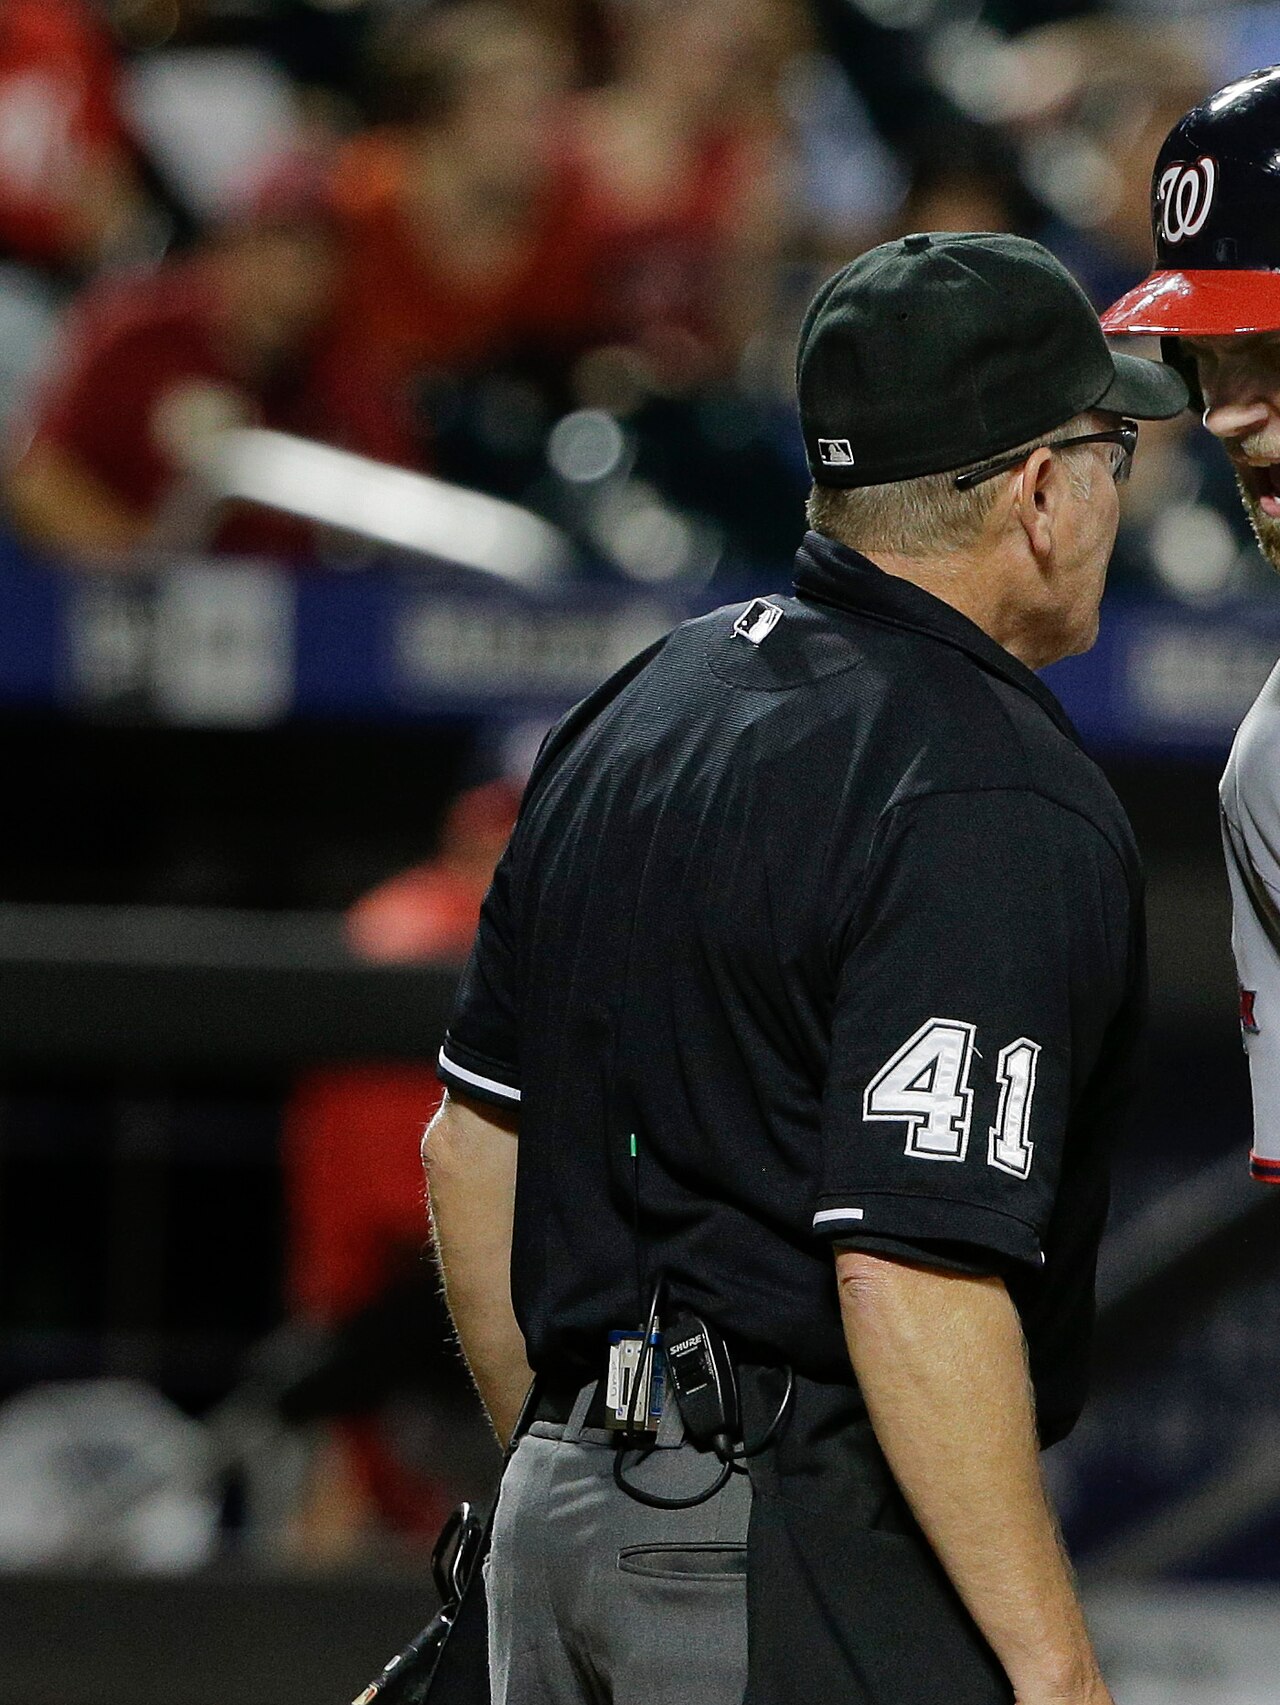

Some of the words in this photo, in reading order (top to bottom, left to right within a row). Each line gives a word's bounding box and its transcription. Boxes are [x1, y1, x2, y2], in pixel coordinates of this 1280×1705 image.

[1159, 157, 1216, 243] W
[862, 1017, 1042, 1181] 41
[669, 1334, 702, 1355] SHURE
